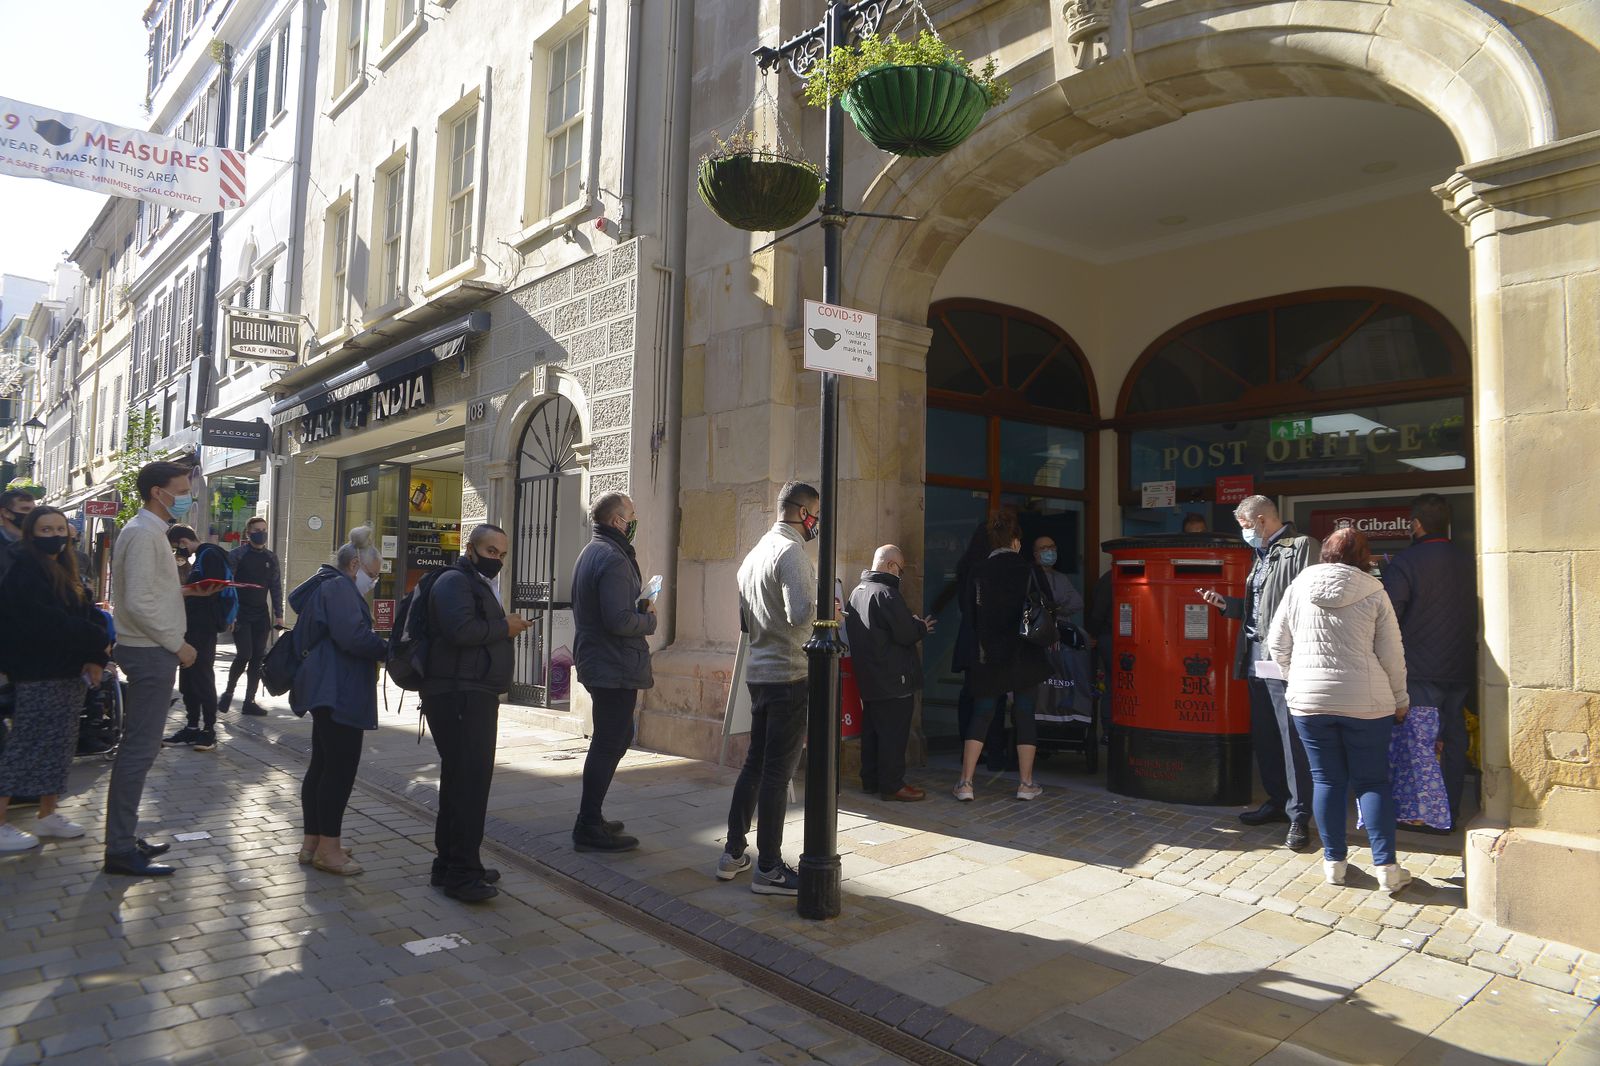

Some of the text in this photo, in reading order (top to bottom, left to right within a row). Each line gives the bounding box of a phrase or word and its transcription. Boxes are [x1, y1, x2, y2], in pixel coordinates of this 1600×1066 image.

[84, 131, 209, 173] MEASURES
[56, 150, 98, 167] MASK
[101, 158, 115, 169] IN
[118, 161, 144, 179] THIS
[146, 171, 179, 183] AREA
[15, 159, 39, 171] SAFE
[92, 175, 131, 191] MINIMISE
[164, 190, 202, 203] CONTACT
[818, 306, 863, 323] COVID-19
[233, 320, 296, 344] PERFUMERY
[845, 328, 854, 336] You
[843, 346, 856, 354] mask
[863, 348, 873, 356] this
[372, 375, 426, 420] INDIA
[468, 402, 484, 420] 108
[209, 429, 261, 438] PEACOCKS
[1163, 424, 1422, 470] POST OFFICE
[351, 475, 369, 487] CHANEL
[417, 559, 448, 567] CHANEL
[1174, 699, 1219, 712] ROYAL
[1179, 711, 1215, 722] MAIL
